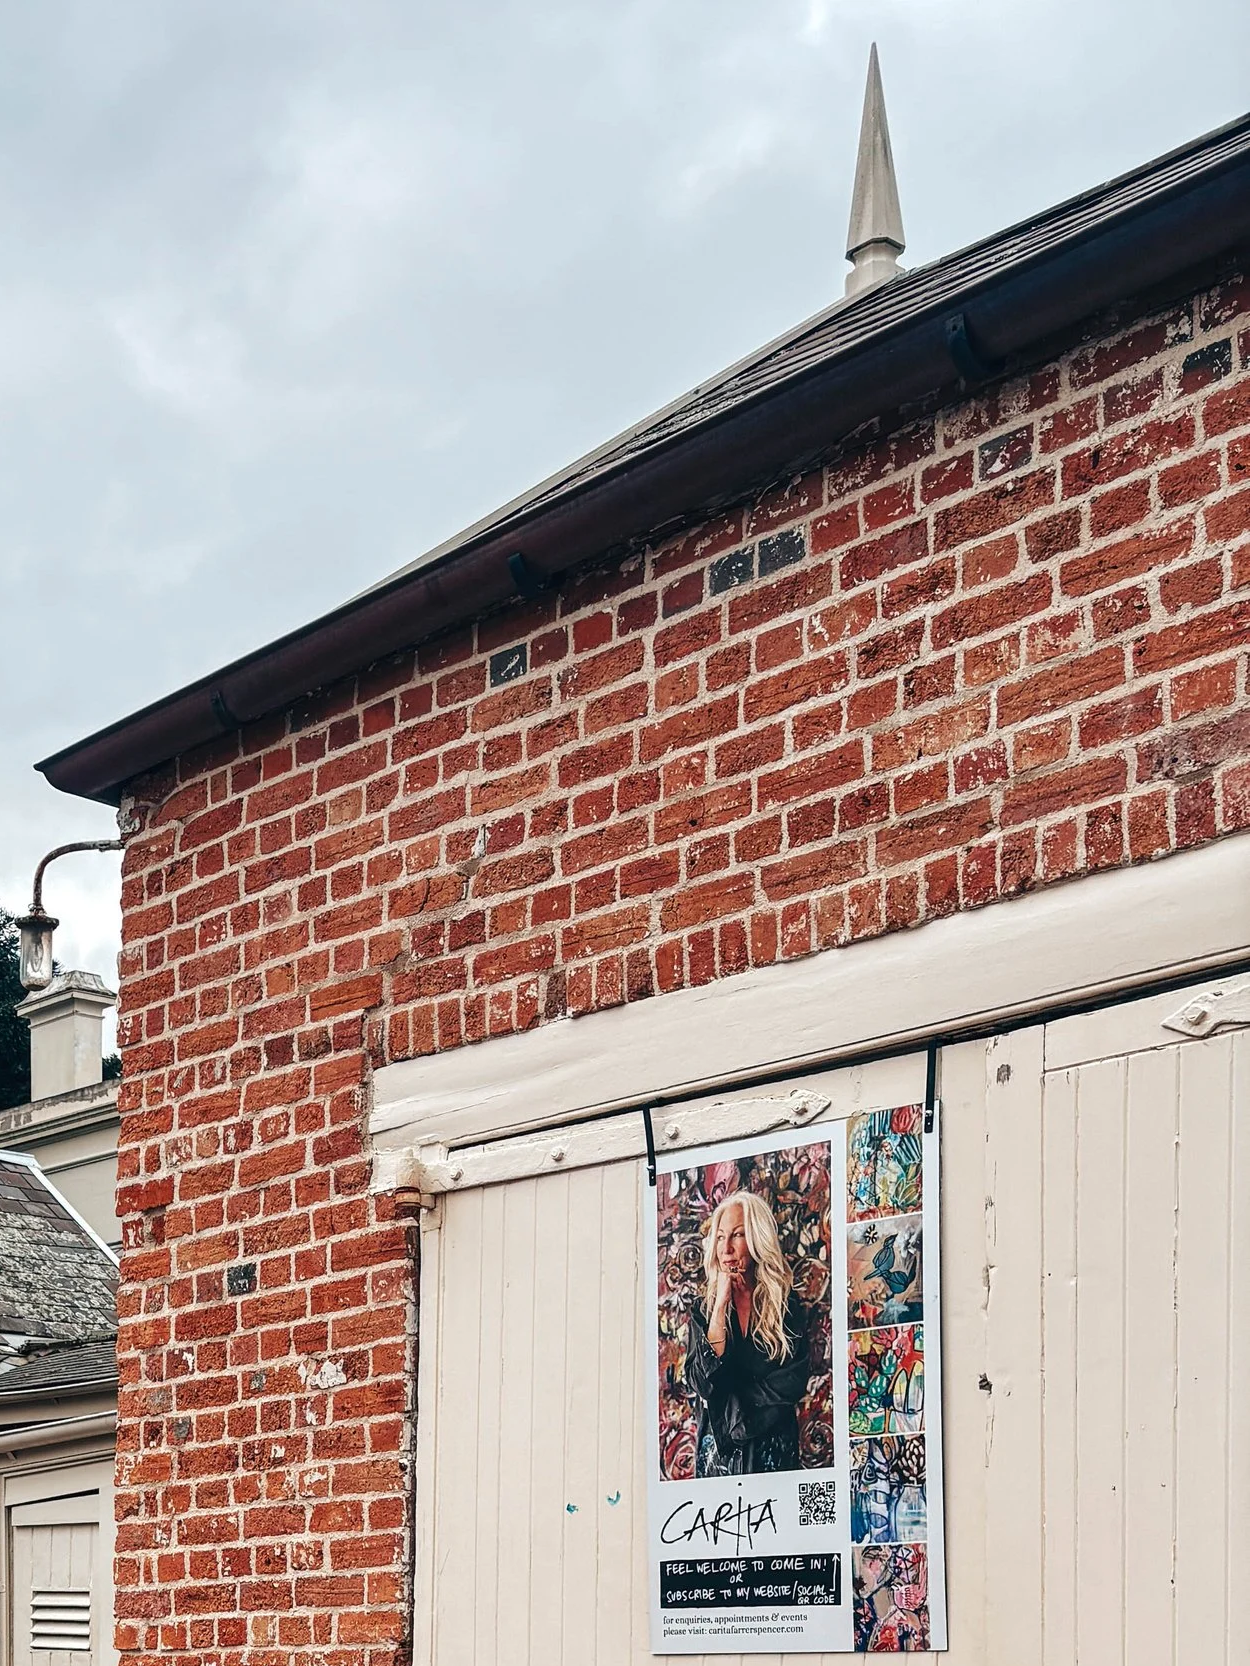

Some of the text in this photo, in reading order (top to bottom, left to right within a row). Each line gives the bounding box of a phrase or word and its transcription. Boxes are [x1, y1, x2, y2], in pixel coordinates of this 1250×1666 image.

[666, 1558, 826, 1576] FEEL WELCOME TO COME IN!
[730, 1573, 743, 1583] OR
[667, 1589, 715, 1602] SUBSCRIBE
[720, 1589, 731, 1599] TO
[737, 1587, 750, 1600] MY
[814, 1595, 834, 1604] CODE
[663, 1616, 673, 1624] for
[676, 1615, 712, 1625] enquiries,
[714, 1614, 769, 1624] appointments
[771, 1613, 779, 1621] &
[663, 1627, 686, 1637] please
[709, 1626, 803, 1635] caritafarrerspencer.com
